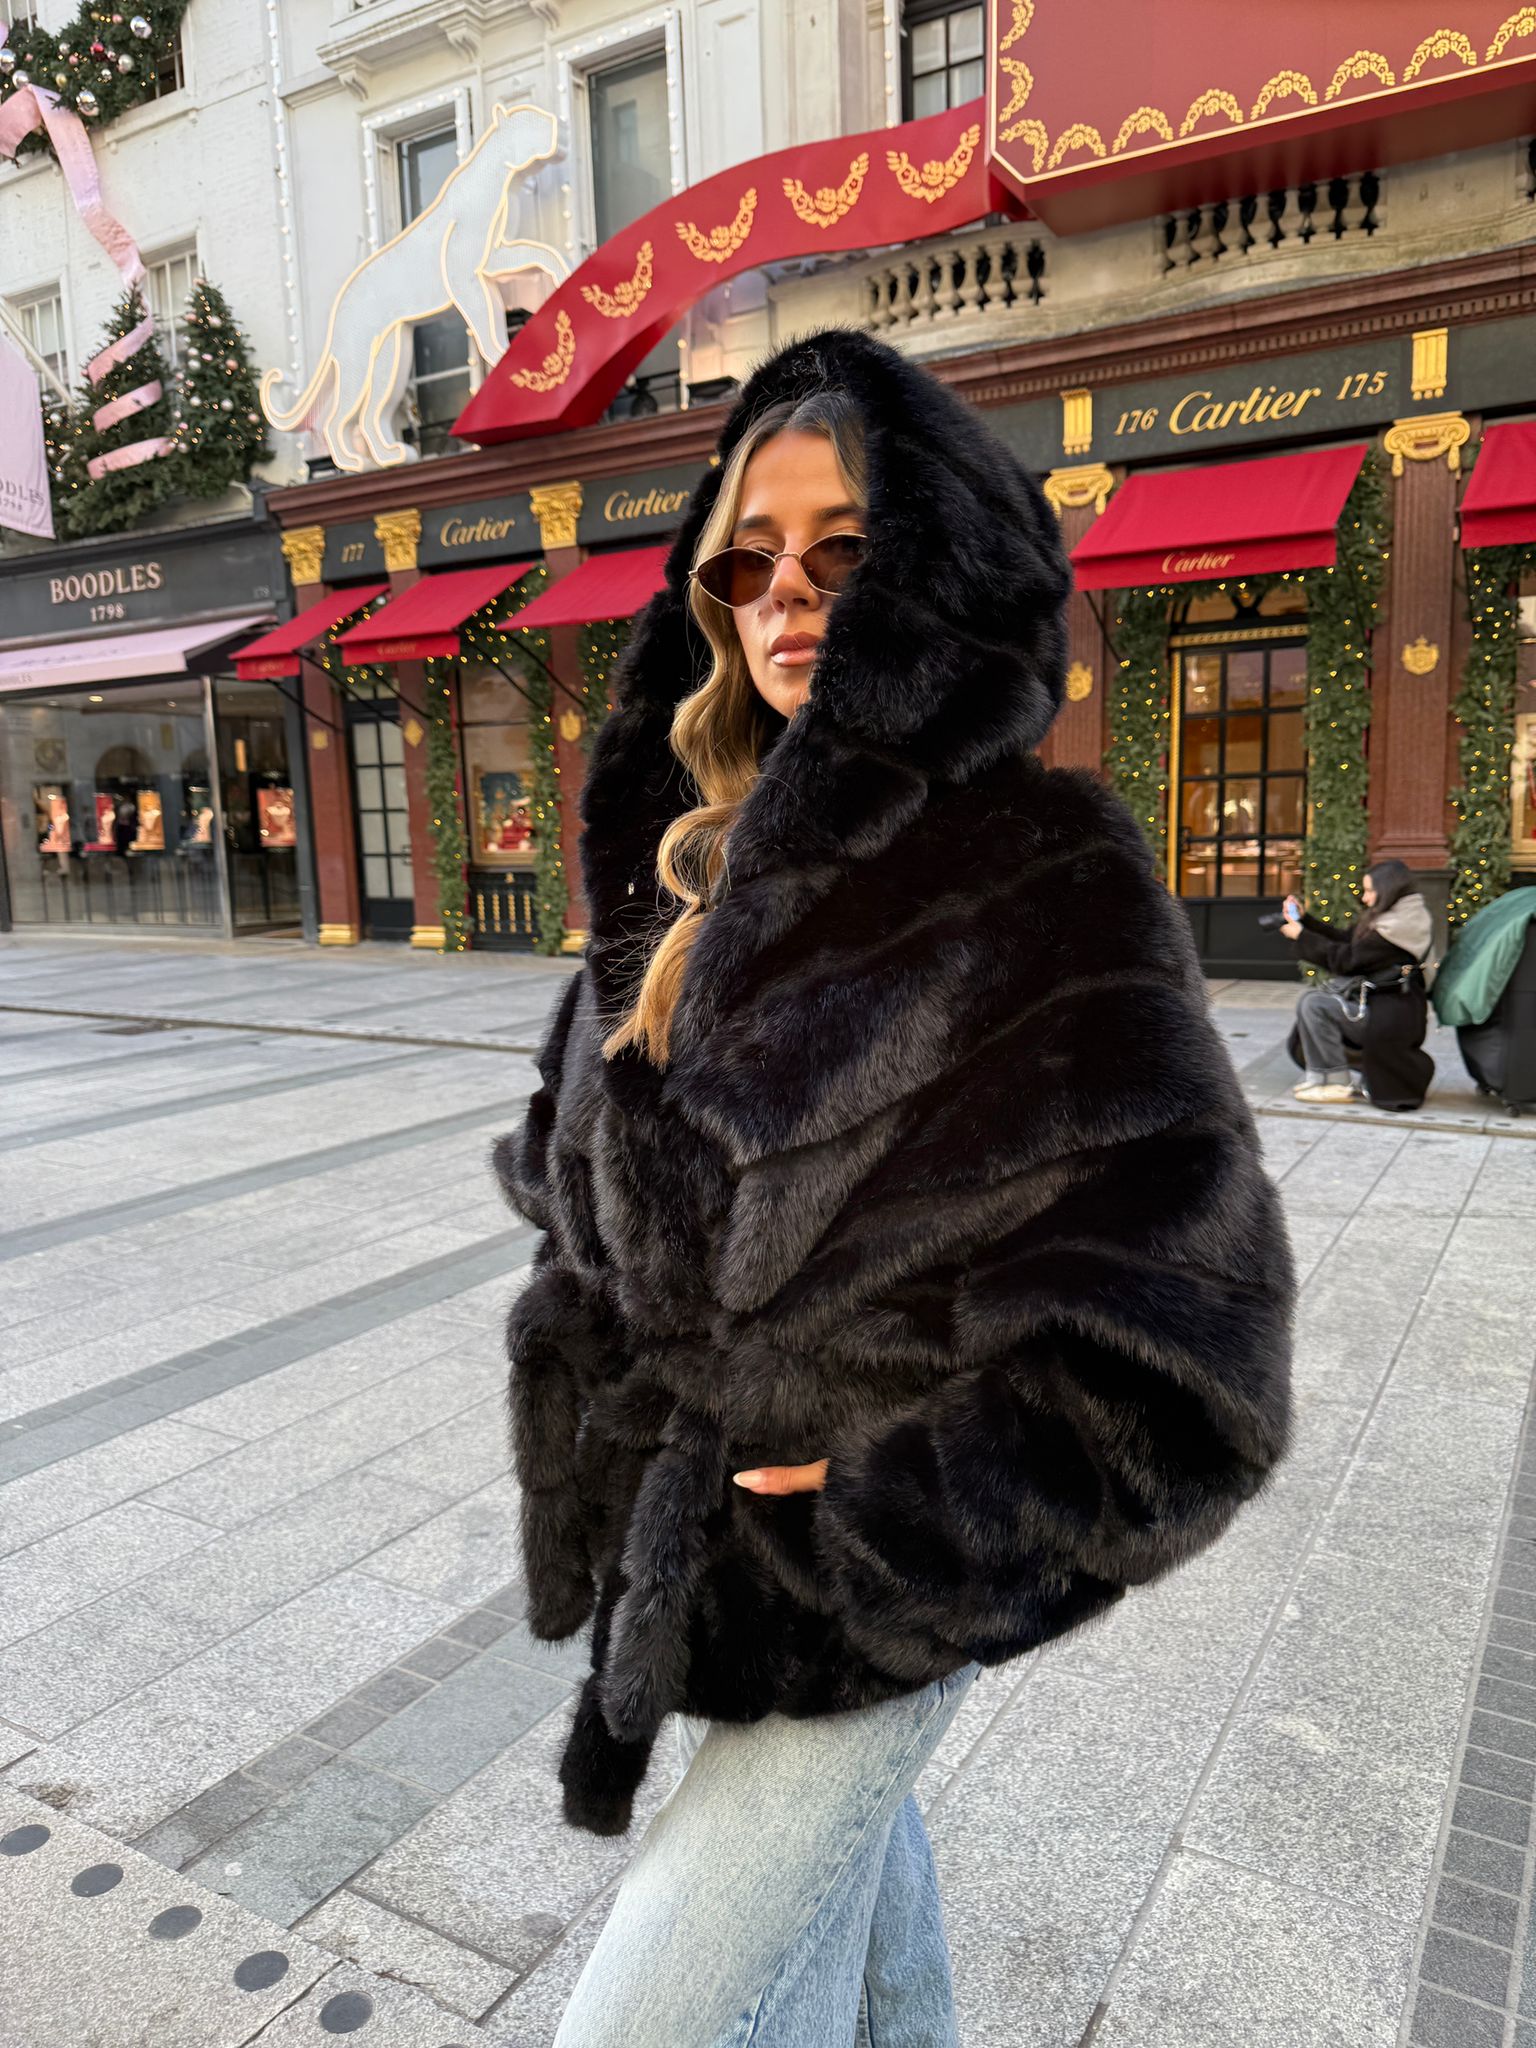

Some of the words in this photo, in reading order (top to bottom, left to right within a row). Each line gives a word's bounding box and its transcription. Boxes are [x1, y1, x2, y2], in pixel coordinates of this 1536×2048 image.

[1113, 407, 1159, 436] 176
[1169, 385, 1321, 434] Cartier
[1336, 371, 1389, 400] 175
[604, 488, 690, 522] Cartier
[440, 516, 515, 547] Cartier
[1162, 551, 1235, 574] Cartier
[49, 561, 162, 603] BOODLES
[89, 602, 125, 622] 1798
